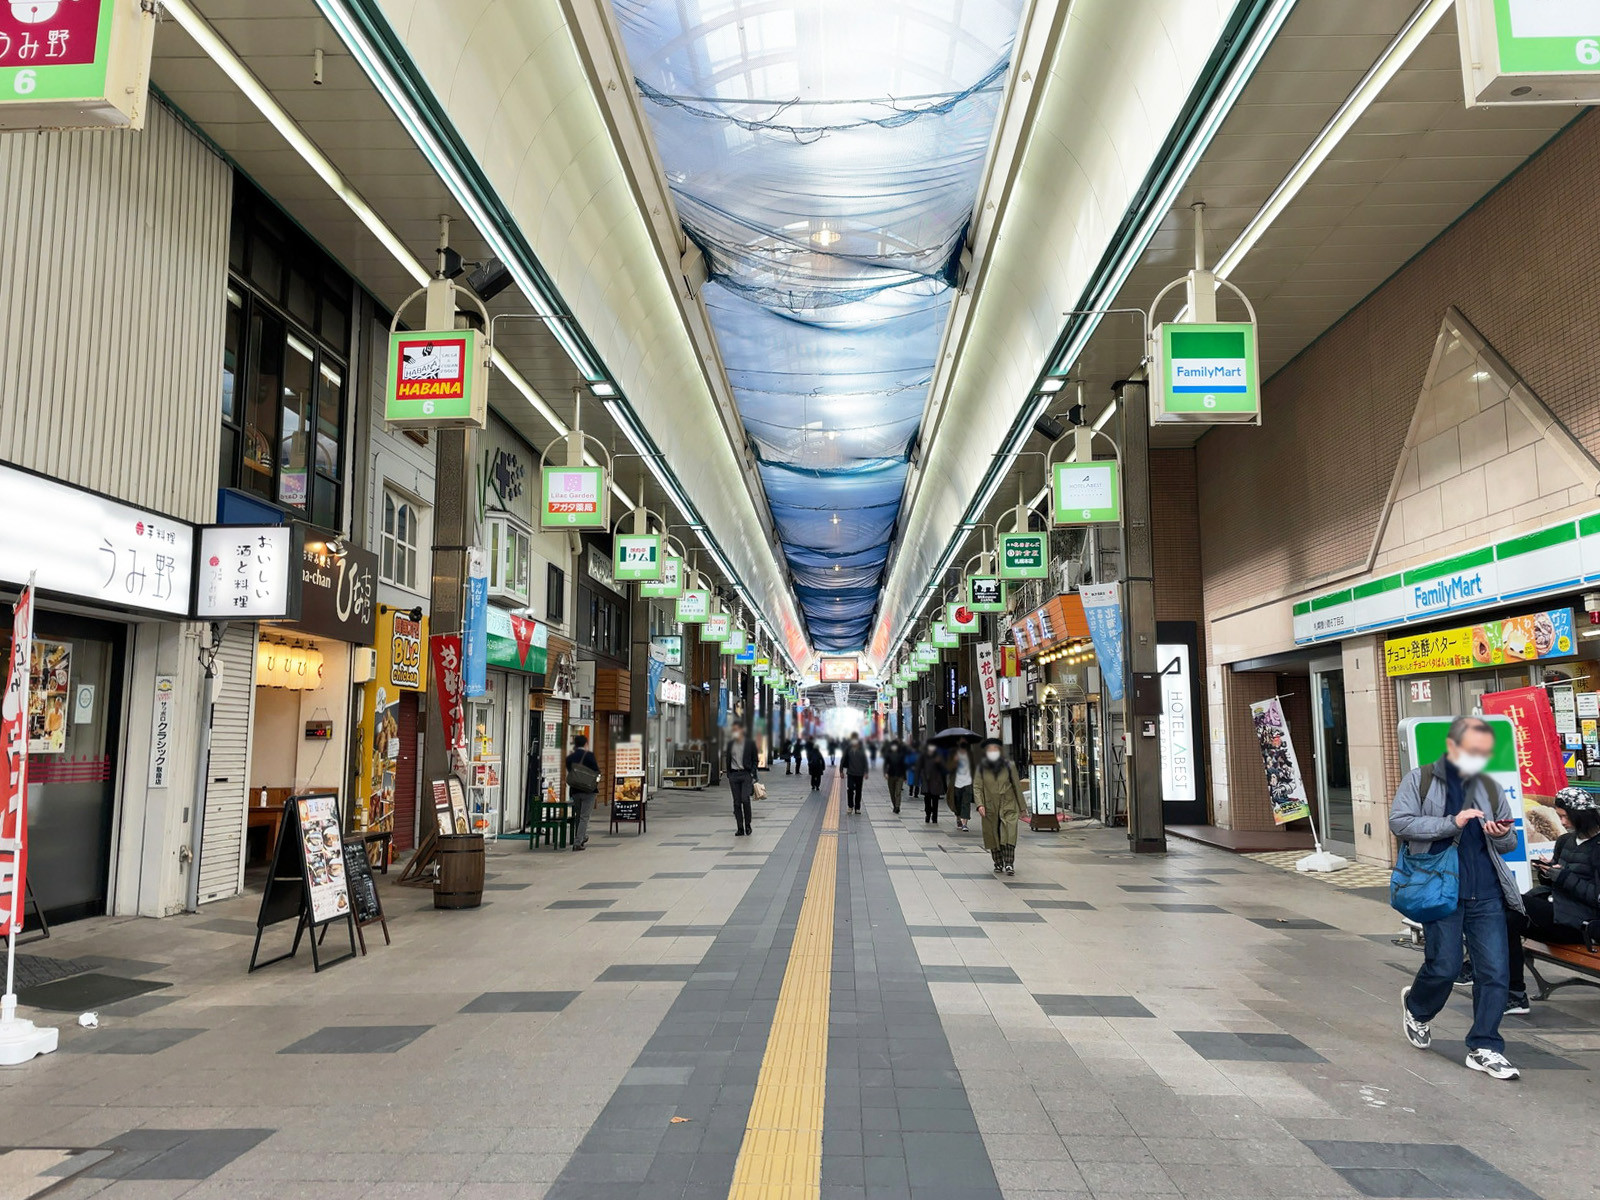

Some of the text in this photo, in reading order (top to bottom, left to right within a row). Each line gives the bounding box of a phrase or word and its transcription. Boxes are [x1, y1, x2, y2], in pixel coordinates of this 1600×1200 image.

[0, 30, 69, 58] うみ野
[1575, 39, 1600, 65] 6
[14, 69, 37, 94] 6
[1177, 366, 1242, 378] FamilyMart
[398, 382, 461, 396] HABANA
[1203, 395, 1217, 408] 6
[422, 401, 435, 414] 6
[567, 513, 576, 523] 6
[1082, 509, 1091, 519] 6
[99, 538, 175, 601] うみ野
[255, 535, 273, 599] おいしい
[628, 553, 649, 562] リム
[233, 545, 251, 608] 酒と料理
[1414, 573, 1482, 608] FamilyMart
[394, 638, 419, 667] BLC
[1171, 691, 1185, 737] HOTEL
[1505, 704, 1541, 788] 中華まん
